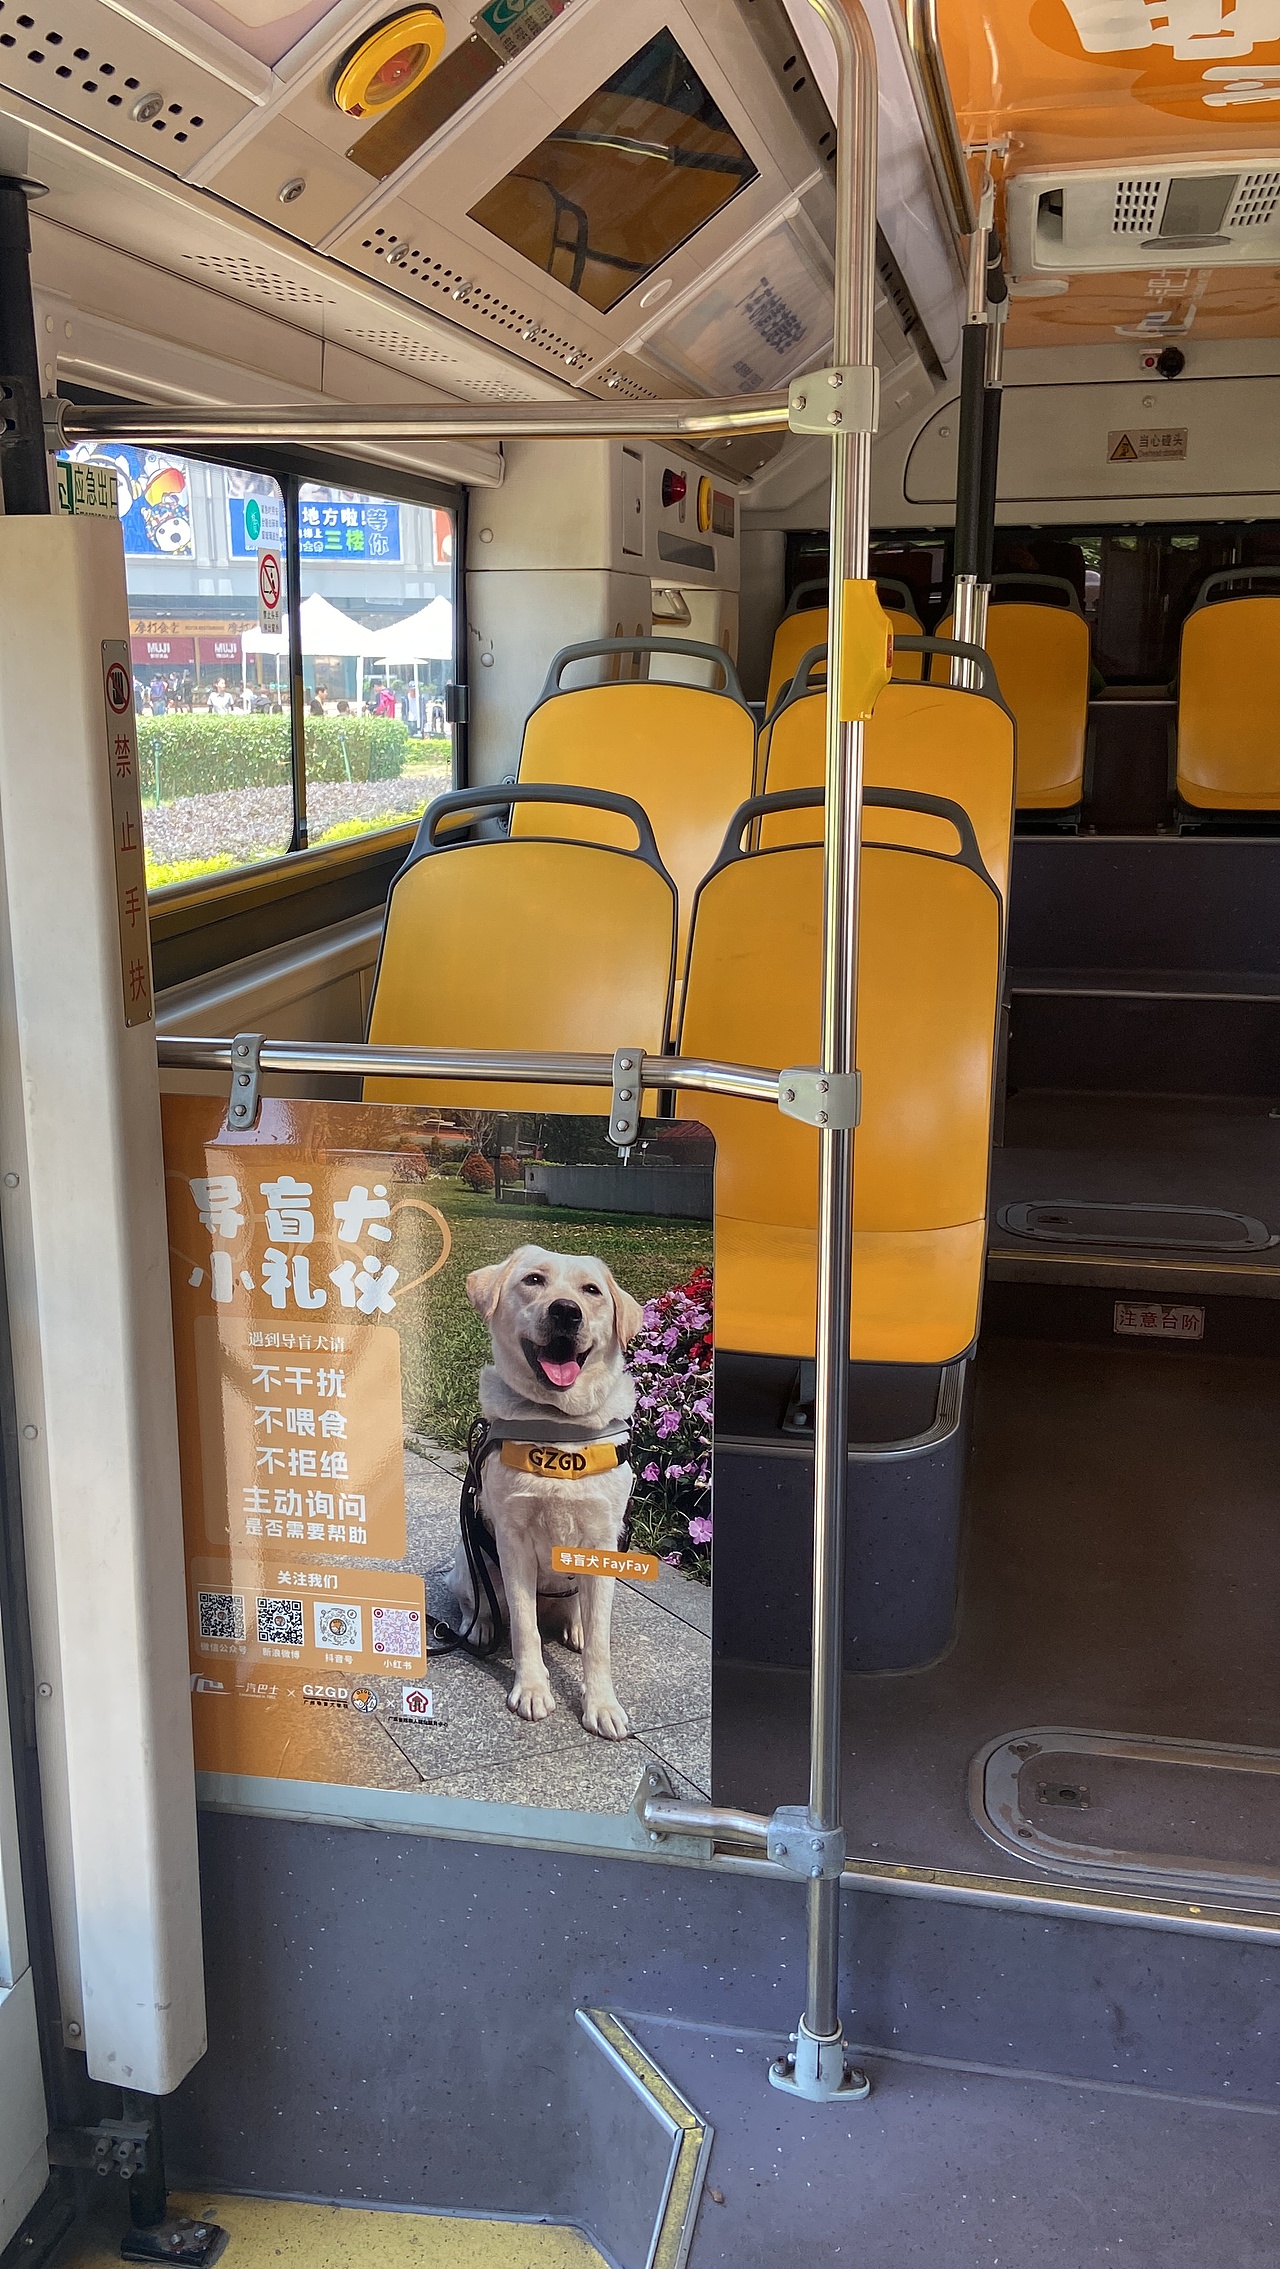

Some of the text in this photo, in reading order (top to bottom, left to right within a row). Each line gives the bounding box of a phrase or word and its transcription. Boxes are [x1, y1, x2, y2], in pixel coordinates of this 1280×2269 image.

[1139, 433, 1183, 448] 当心碰头
[74, 465, 118, 508] 应急出口
[302, 506, 367, 527] 地方啦!
[325, 529, 364, 551] 三楼
[147, 642, 171, 654] MUJI
[214, 642, 237, 654] MUJI
[114, 733, 147, 1003] 禁止手扶
[188, 1175, 392, 1242] 导盲犬
[188, 1247, 400, 1315] 小礼仪
[1119, 1309, 1200, 1331] 注意台阶
[248, 1331, 345, 1353] 遇到导盲犬请
[252, 1364, 347, 1399] 不干扰
[254, 1405, 348, 1440] 不喂食
[256, 1446, 350, 1480] 不拒绝
[528, 1449, 587, 1471] GZGD
[243, 1485, 367, 1522] 主动询问
[245, 1517, 367, 1545] 是否需要帮助
[559, 1552, 650, 1575] 导盲犬 FayFay
[277, 1570, 338, 1590] 关注我们
[200, 1641, 247, 1656] 微信公众号
[262, 1647, 300, 1660] 新浪微博
[325, 1653, 354, 1665] 抖音号
[383, 1659, 413, 1671] 小红书
[235, 1682, 279, 1696] 一汽巴士
[302, 1684, 348, 1699] GZGD
